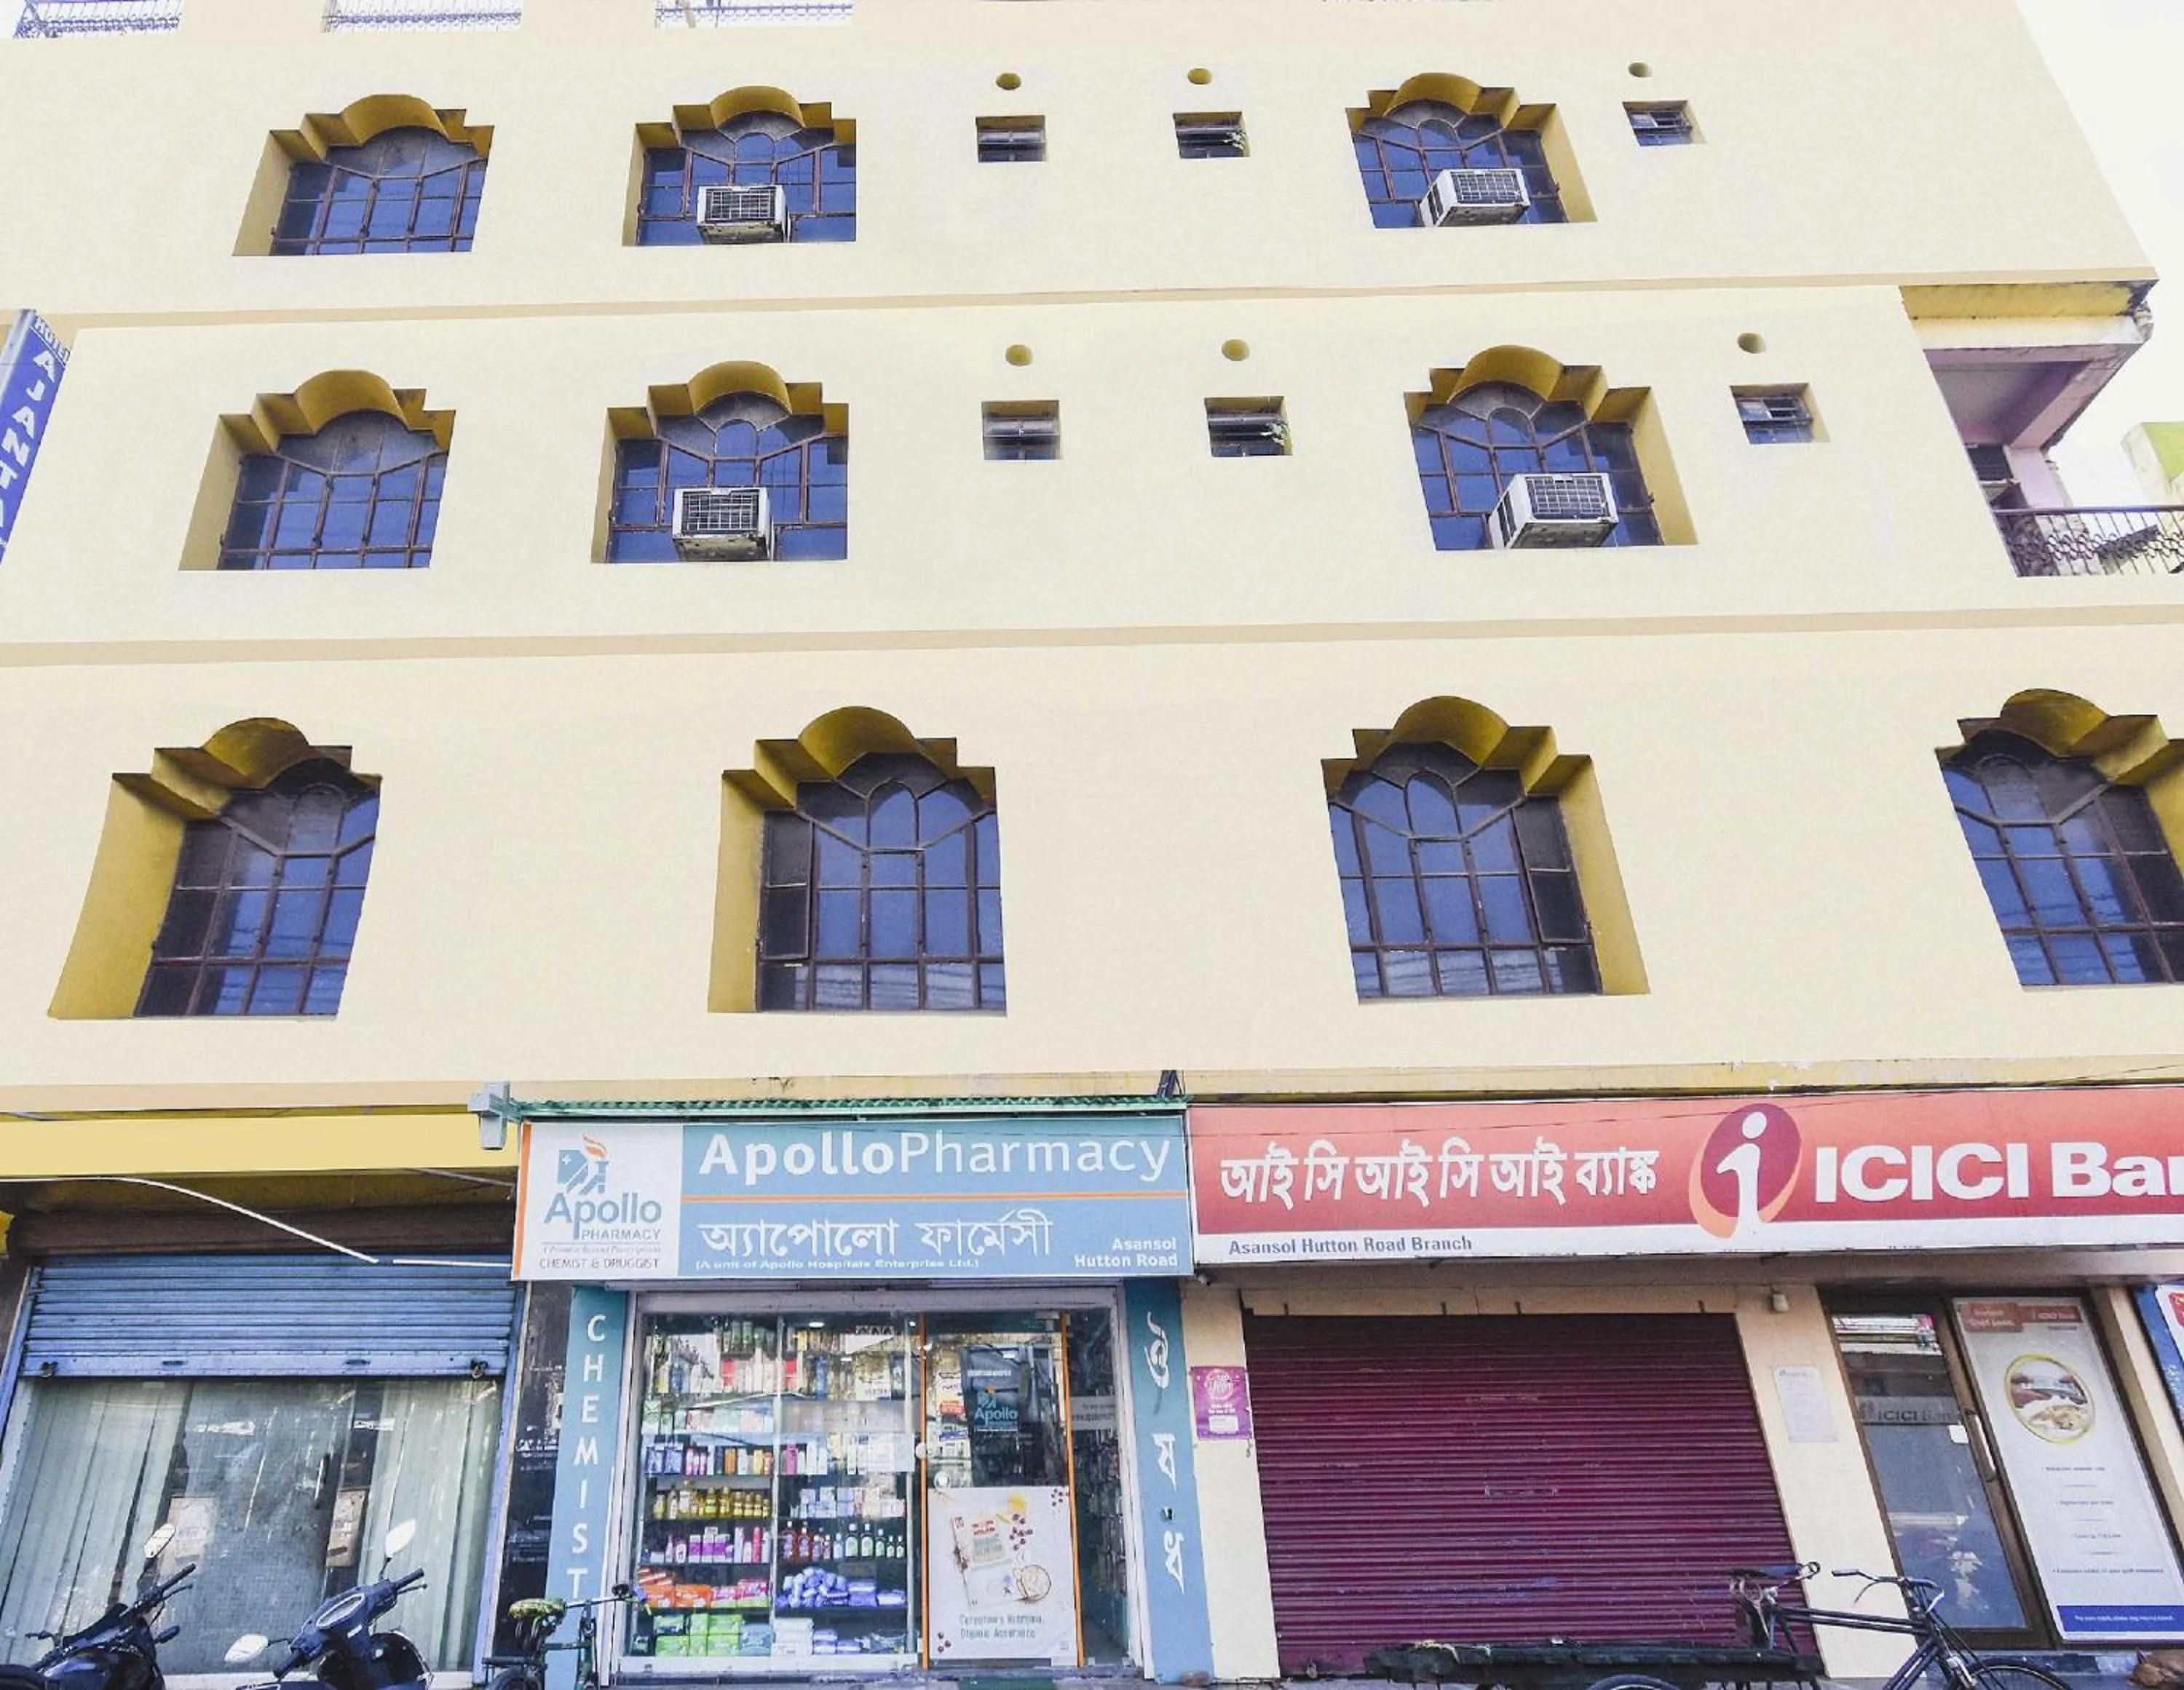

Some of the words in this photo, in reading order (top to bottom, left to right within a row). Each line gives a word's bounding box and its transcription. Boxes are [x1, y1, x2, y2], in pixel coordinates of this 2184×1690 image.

[0, 350, 55, 528] AJANT
[1220, 1141, 1298, 1210] আই
[1304, 1139, 1349, 1202] সি
[1355, 1139, 1433, 1207] আই
[1439, 1138, 1484, 1198] সি
[1489, 1136, 1567, 1206] আই
[1816, 1143, 2030, 1203] ICICI
[544, 1192, 662, 1240] Apollo
[582, 1229, 661, 1240] PHARMACY
[698, 1218, 900, 1258] অ্যাপোলো
[1112, 1237, 1176, 1251] Asansol
[1228, 1238, 1296, 1255] Asansol
[1302, 1237, 1357, 1253] Hutton
[1364, 1237, 1406, 1252] Road
[1411, 1235, 1472, 1252] Branch
[539, 1258, 585, 1269] CHEMIST
[743, 1261, 756, 1269] of
[760, 1261, 803, 1270] Apollo
[1074, 1255, 1129, 1268] Hutton
[1136, 1253, 1178, 1267] Road
[975, 1406, 1018, 1426] Apollo
[565, 1314, 606, 1600] CHEMIST
